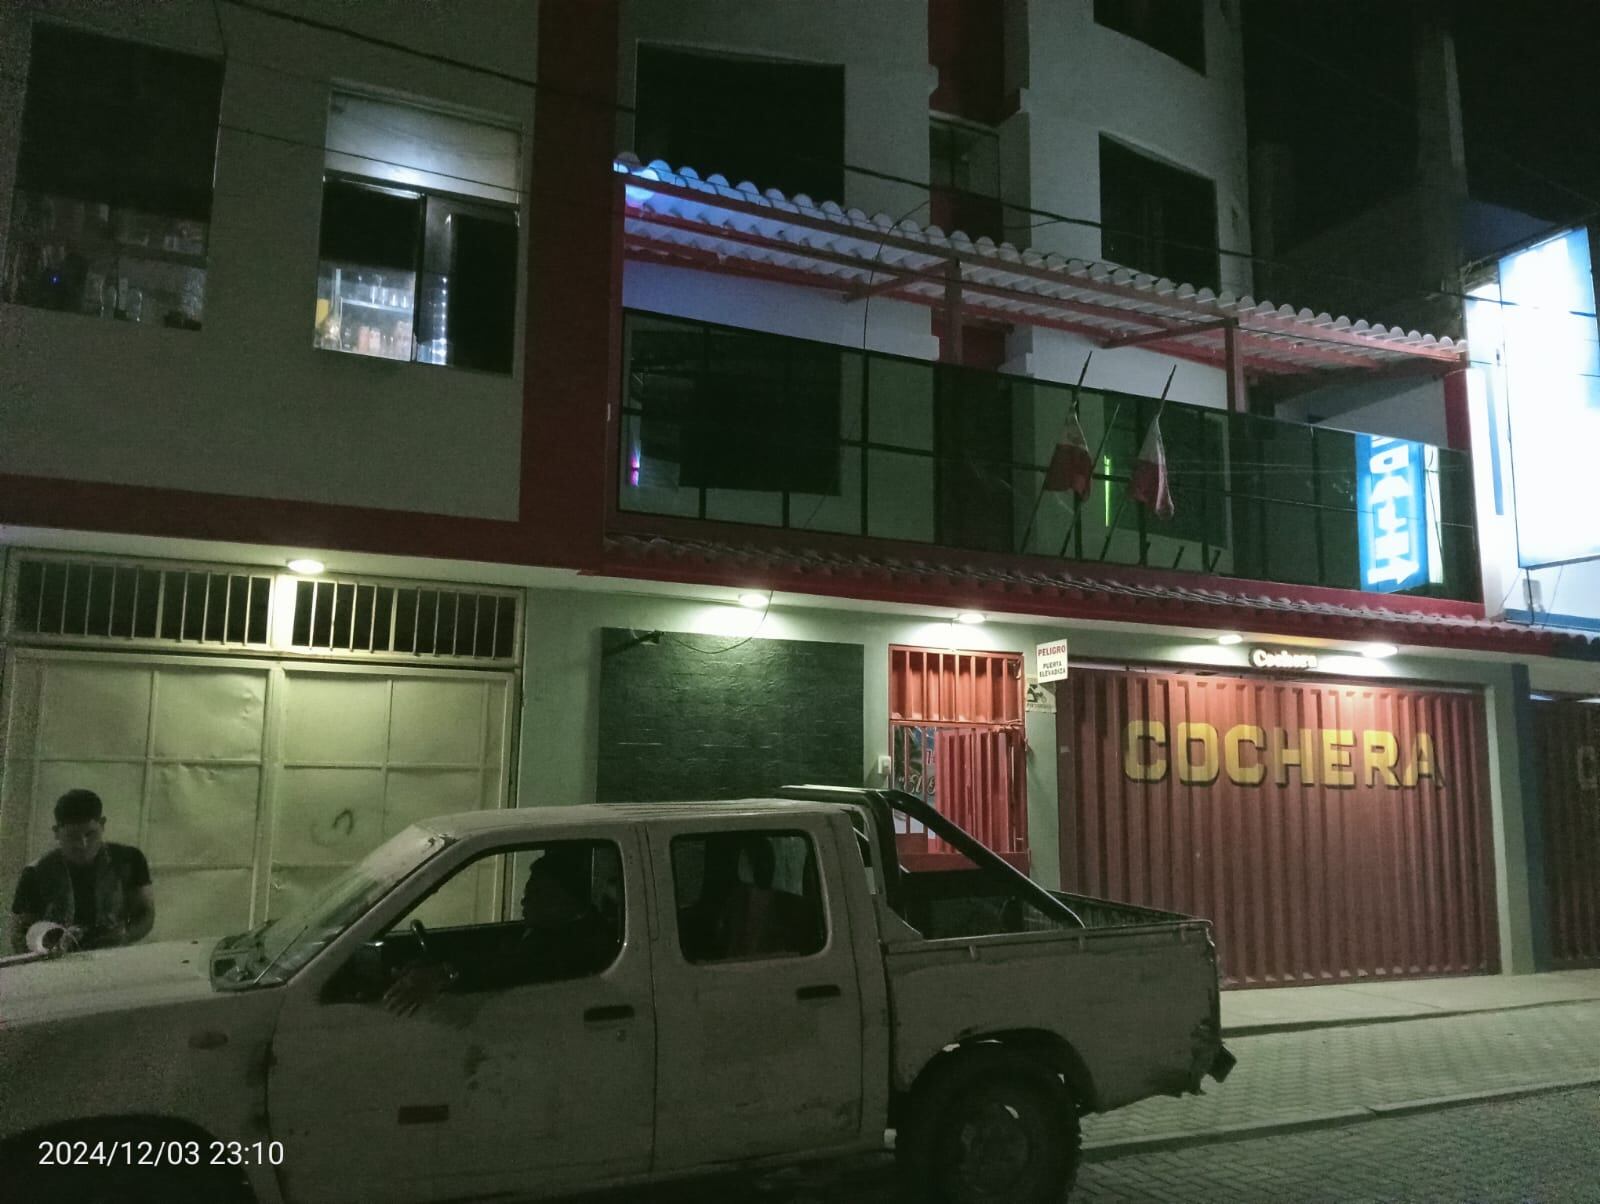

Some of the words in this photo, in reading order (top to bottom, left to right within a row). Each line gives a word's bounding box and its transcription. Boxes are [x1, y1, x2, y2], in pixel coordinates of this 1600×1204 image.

[1037, 644, 1066, 657] PELIGRO
[1043, 660, 1062, 669] PUERTA
[1125, 720, 1443, 789] COCHERA
